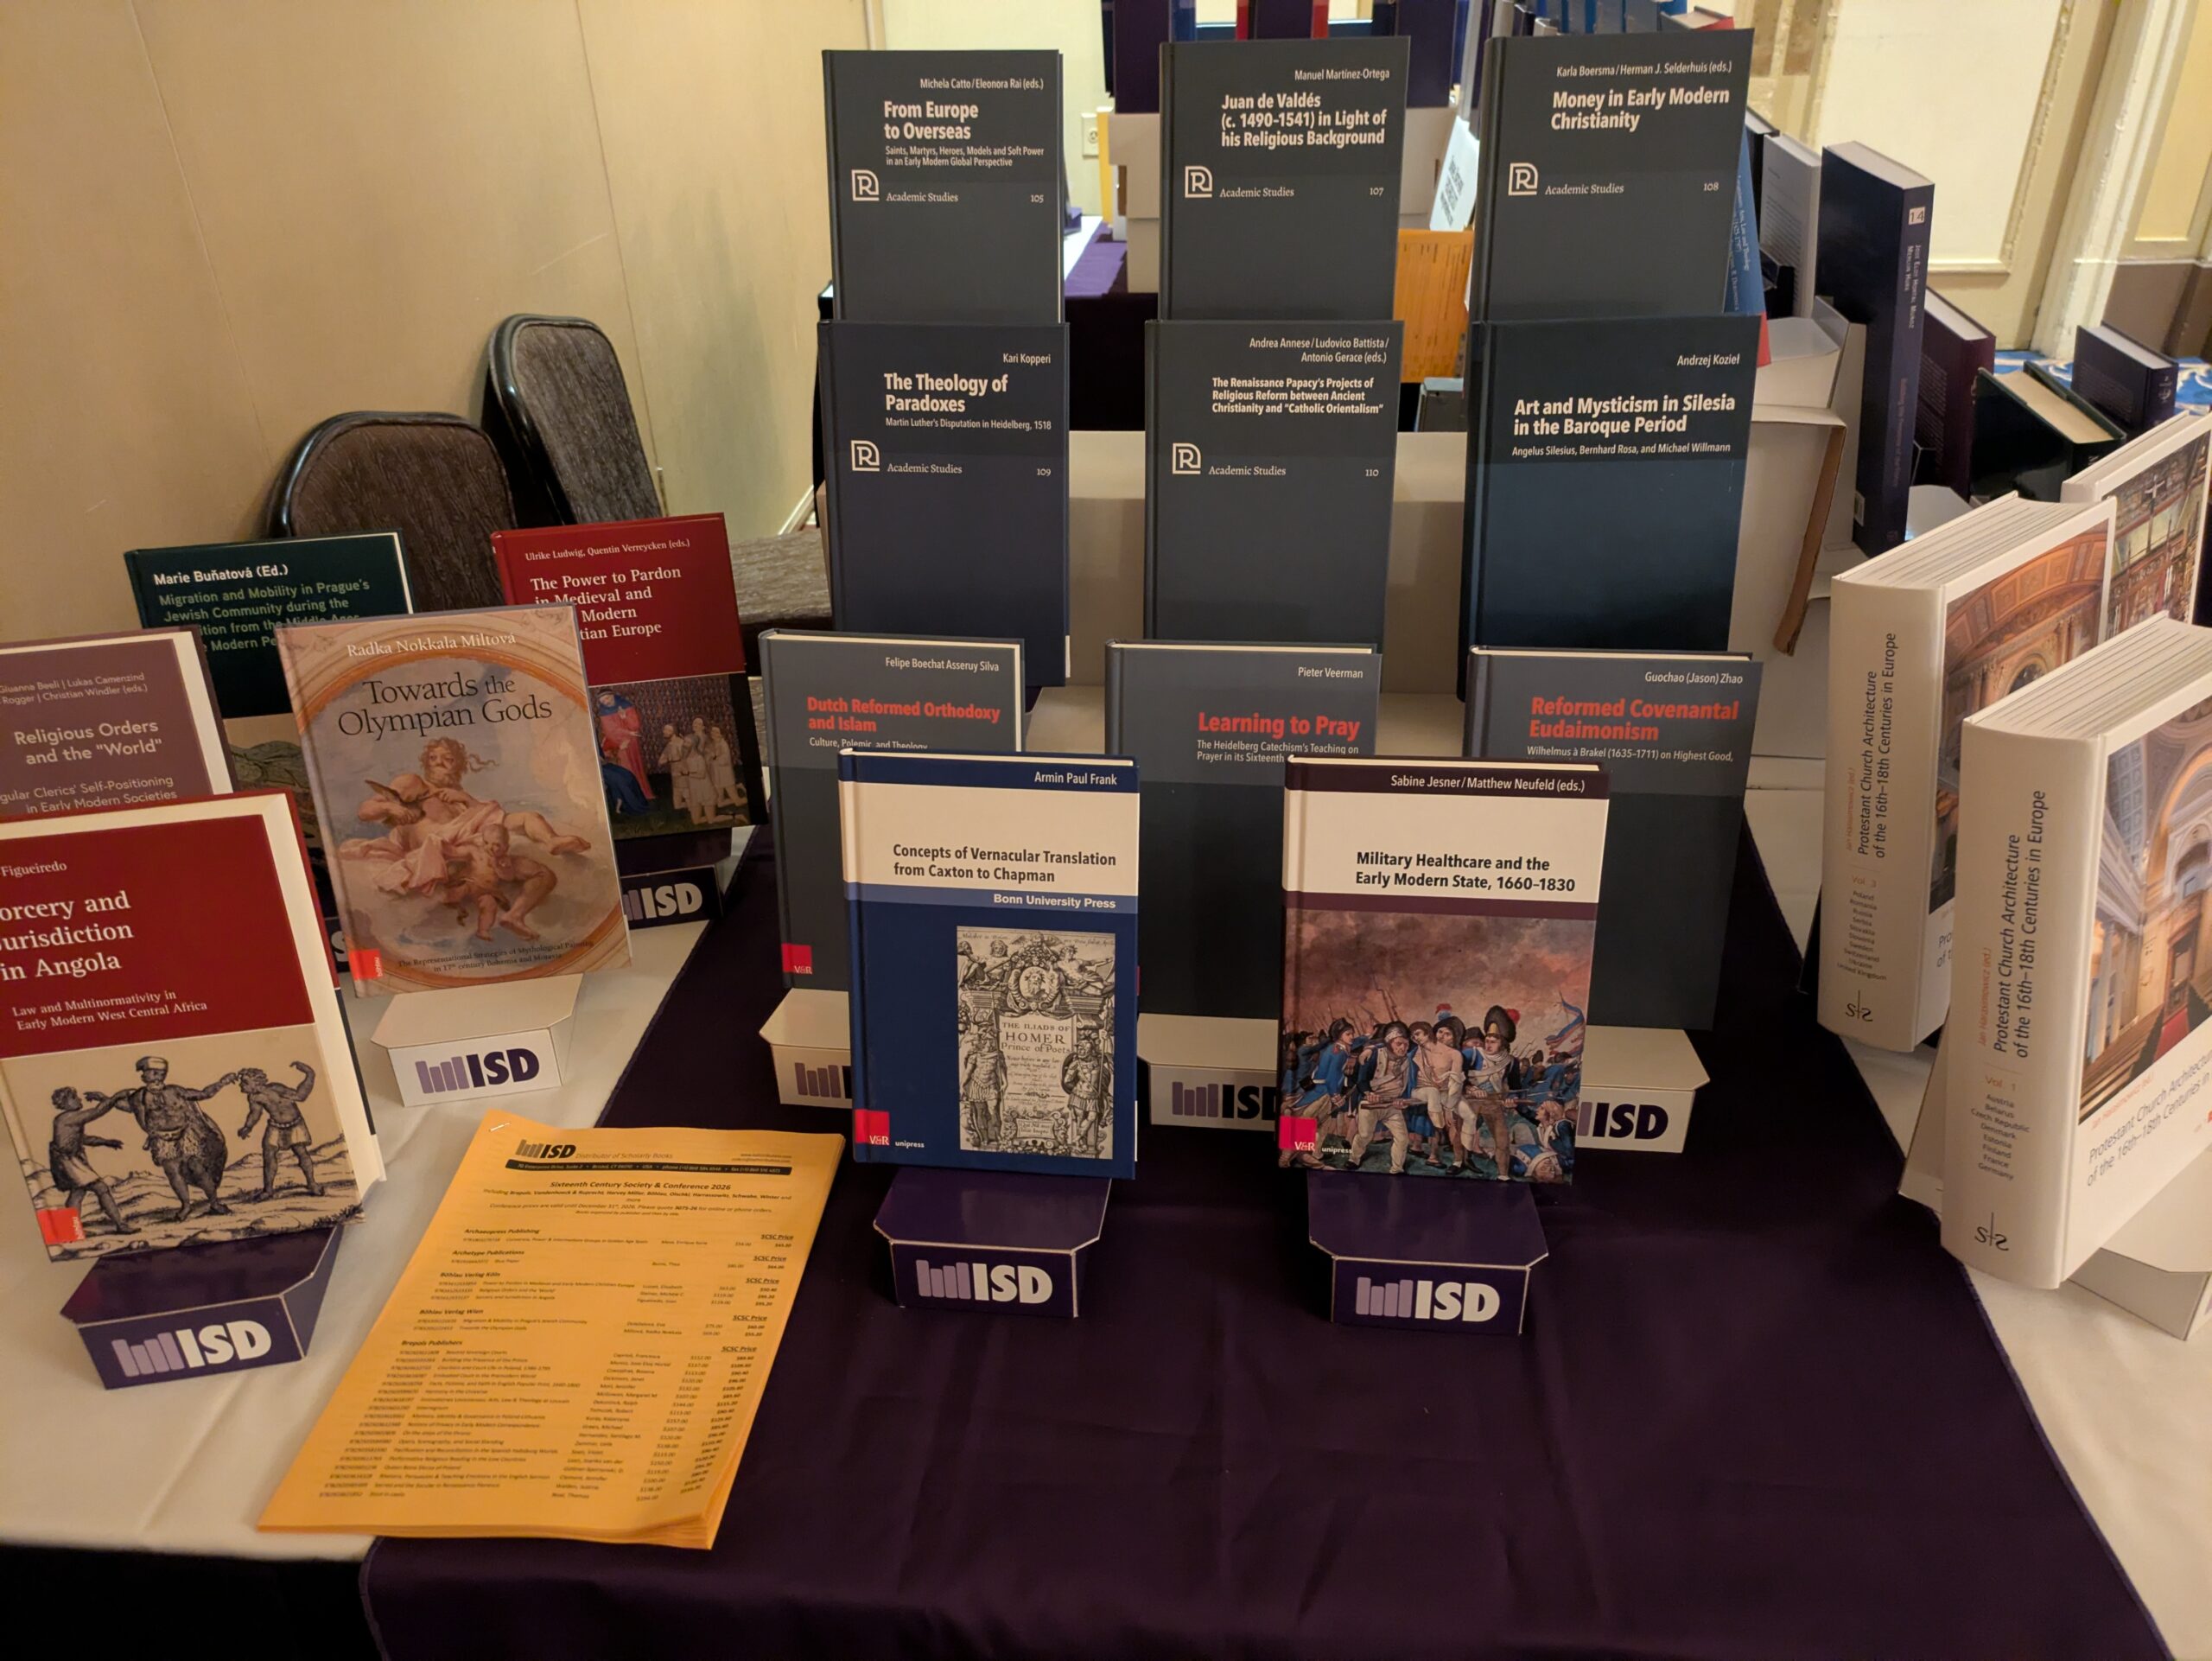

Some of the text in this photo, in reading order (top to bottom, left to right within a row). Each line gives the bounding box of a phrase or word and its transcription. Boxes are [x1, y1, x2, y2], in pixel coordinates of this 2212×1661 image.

[1295, 68, 1389, 80] Manuel Martínez-Ortega
[1222, 92, 1320, 109] Juan de Valdés
[1553, 86, 1729, 111] Money in Early Modern
[885, 101, 978, 123] From Europe
[1222, 113, 1236, 130] (c.
[1319, 111, 1331, 125] in
[1335, 110, 1370, 130] Light
[1372, 109, 1387, 124] of
[1551, 111, 1640, 131] Christianity
[884, 122, 970, 139] to Overseas
[1222, 129, 1384, 150] his Religious Background
[886, 146, 1044, 156] Saints, Martyrs, Heroes, Models and Soft Power
[887, 192, 1044, 203] Academic Studies 105
[1220, 187, 1383, 197] Academic Studies 107
[1545, 182, 1719, 194] Academic Studies 108
[1003, 353, 1051, 366] Kari Kopperi
[1677, 355, 1711, 367] Andrzej
[884, 372, 1007, 396] The Theology of
[1212, 378, 1229, 387] The
[1230, 378, 1284, 387] Renaissance
[1326, 379, 1361, 390] Projects
[1363, 378, 1374, 388] of
[887, 394, 965, 412] Paradoxes
[1213, 390, 1365, 402] Religious Reform between Ancient
[1515, 393, 1735, 418] Art and Mysticism in Silesia
[1514, 415, 1687, 438] in the Baroque Period
[887, 463, 929, 473] Academic
[931, 464, 962, 474] Studies
[1209, 465, 1251, 474] Academic
[1254, 466, 1286, 475] Studies
[154, 564, 288, 585] Marie Buňatová (Ed.)
[531, 567, 681, 590] The Power to Pardon
[159, 592, 218, 607] Migration
[223, 589, 245, 601] and
[248, 585, 296, 598] Mobility
[301, 584, 313, 594] in
[886, 657, 999, 672] Felipe Boechat Asseruy Silva
[1299, 667, 1363, 678] Pieter Veerman
[362, 672, 514, 704] Towards the
[1645, 671, 1743, 684] Guochao (Jason) Zhao
[339, 694, 552, 741] Olympian Gods
[807, 697, 1000, 723] Dutch Reformed Orthodoxy
[1532, 697, 1738, 719] Reformed Covenantal
[14, 721, 158, 745] Religious Orders
[809, 716, 876, 731] and Islam
[1199, 712, 1360, 741] Learning to Pray
[1529, 719, 1658, 740] Eudaimonism
[27, 739, 162, 764] and the "World"
[1034, 772, 1116, 785] Armin Paul Frank
[893, 844, 1116, 865] Concepts of Vernacular Translation
[1357, 852, 1549, 870] Military Healthcare and the
[894, 862, 1054, 884] from Caxton to Chapman
[1357, 872, 1390, 888] Early
[1395, 873, 1448, 887] Modern
[1452, 875, 1491, 890] State,
[994, 894, 1116, 908] Bonn University Press
[1993, 835, 2019, 1053] Protestant Church Architecture
[0, 952, 121, 980] in Angola
[467, 1048, 539, 1087] ISD
[1592, 1103, 1668, 1139] ISD
[538, 1145, 575, 1158] ISD
[972, 1263, 1052, 1303] ISD
[1415, 1281, 1500, 1321] ISD
[175, 1321, 271, 1368] ISD
